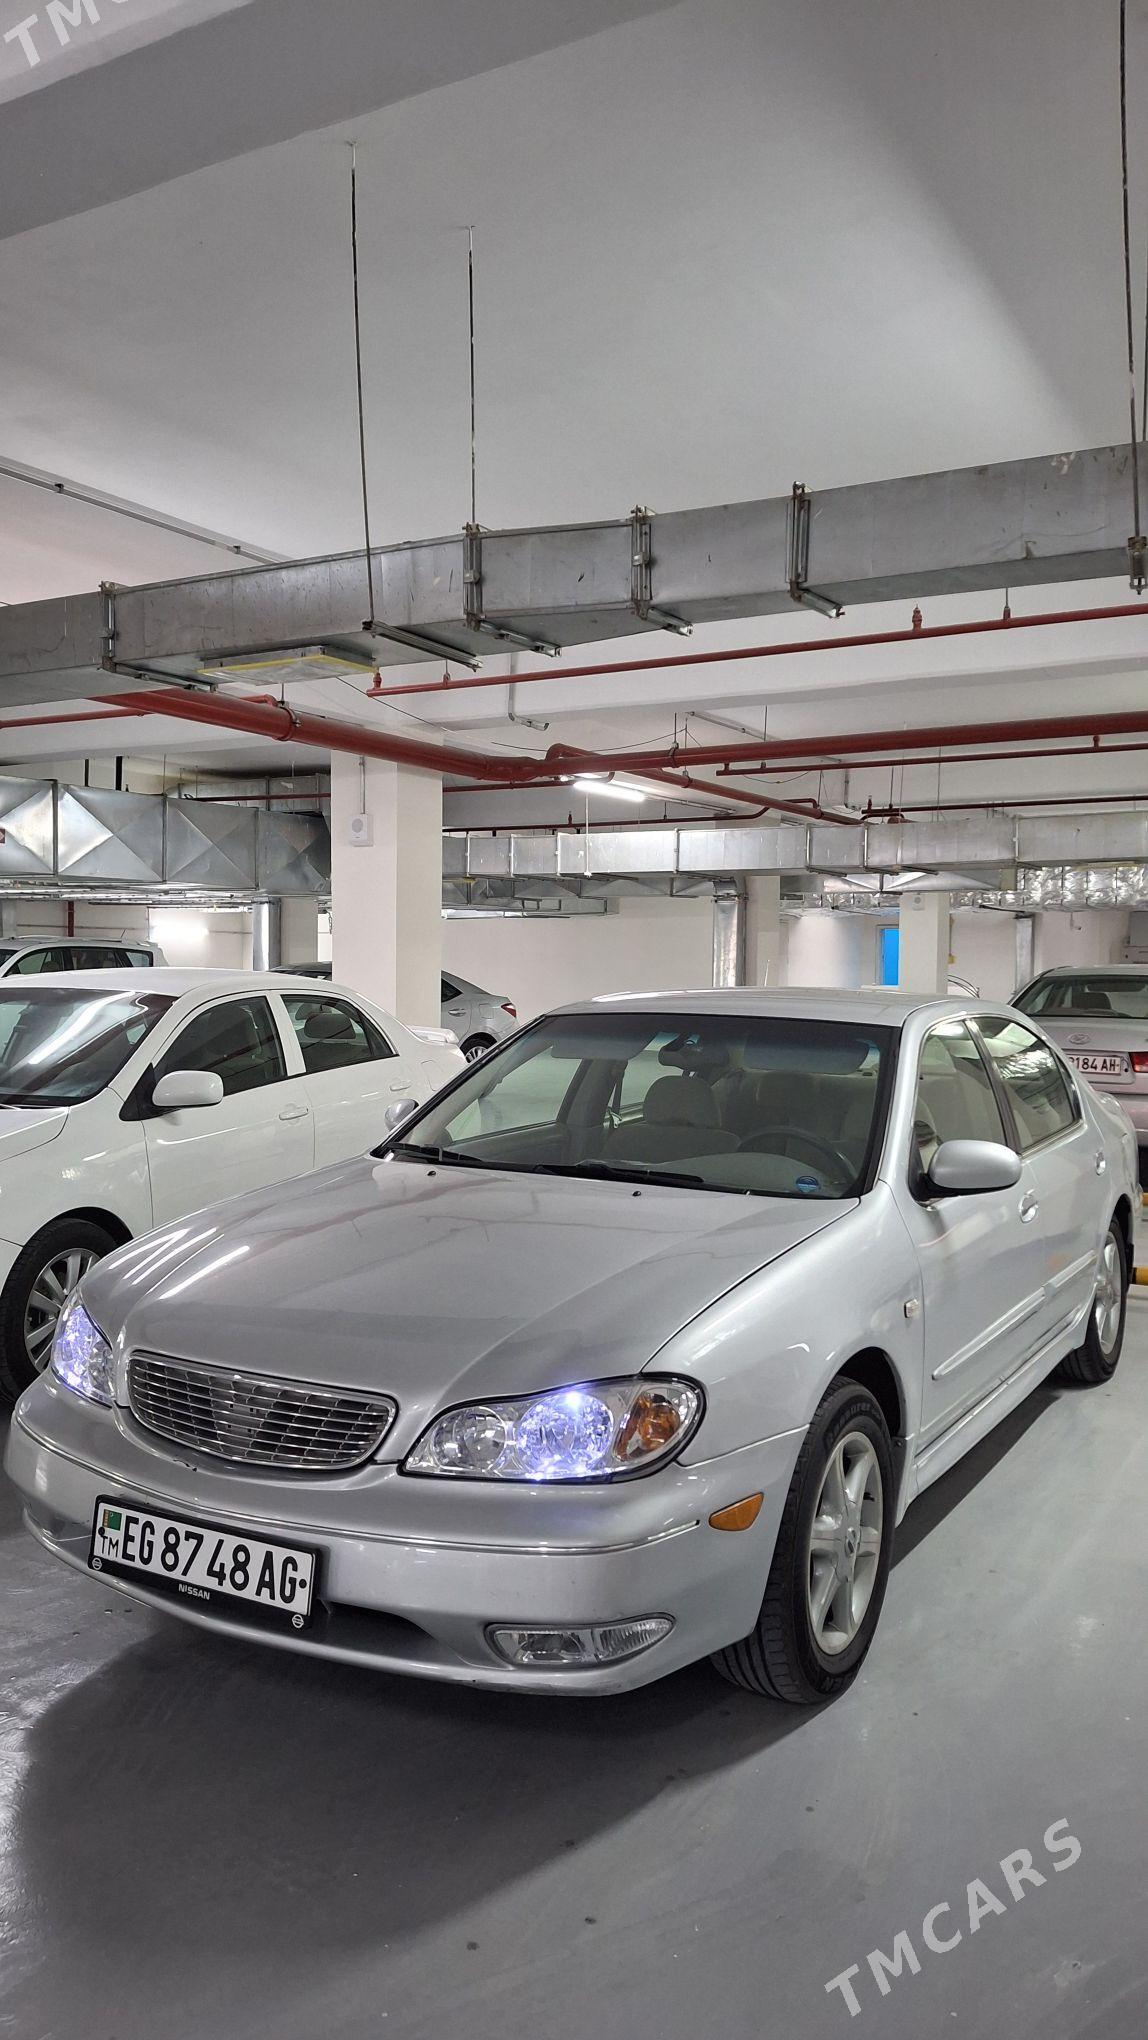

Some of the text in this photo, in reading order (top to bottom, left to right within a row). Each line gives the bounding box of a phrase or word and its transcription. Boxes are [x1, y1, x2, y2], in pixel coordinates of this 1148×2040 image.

[1100, 1058, 1116, 1072] AH
[101, 1535, 119, 1558] TM
[121, 1514, 298, 1604] EG 8748 AG
[178, 1583, 211, 1600] NISSAN
